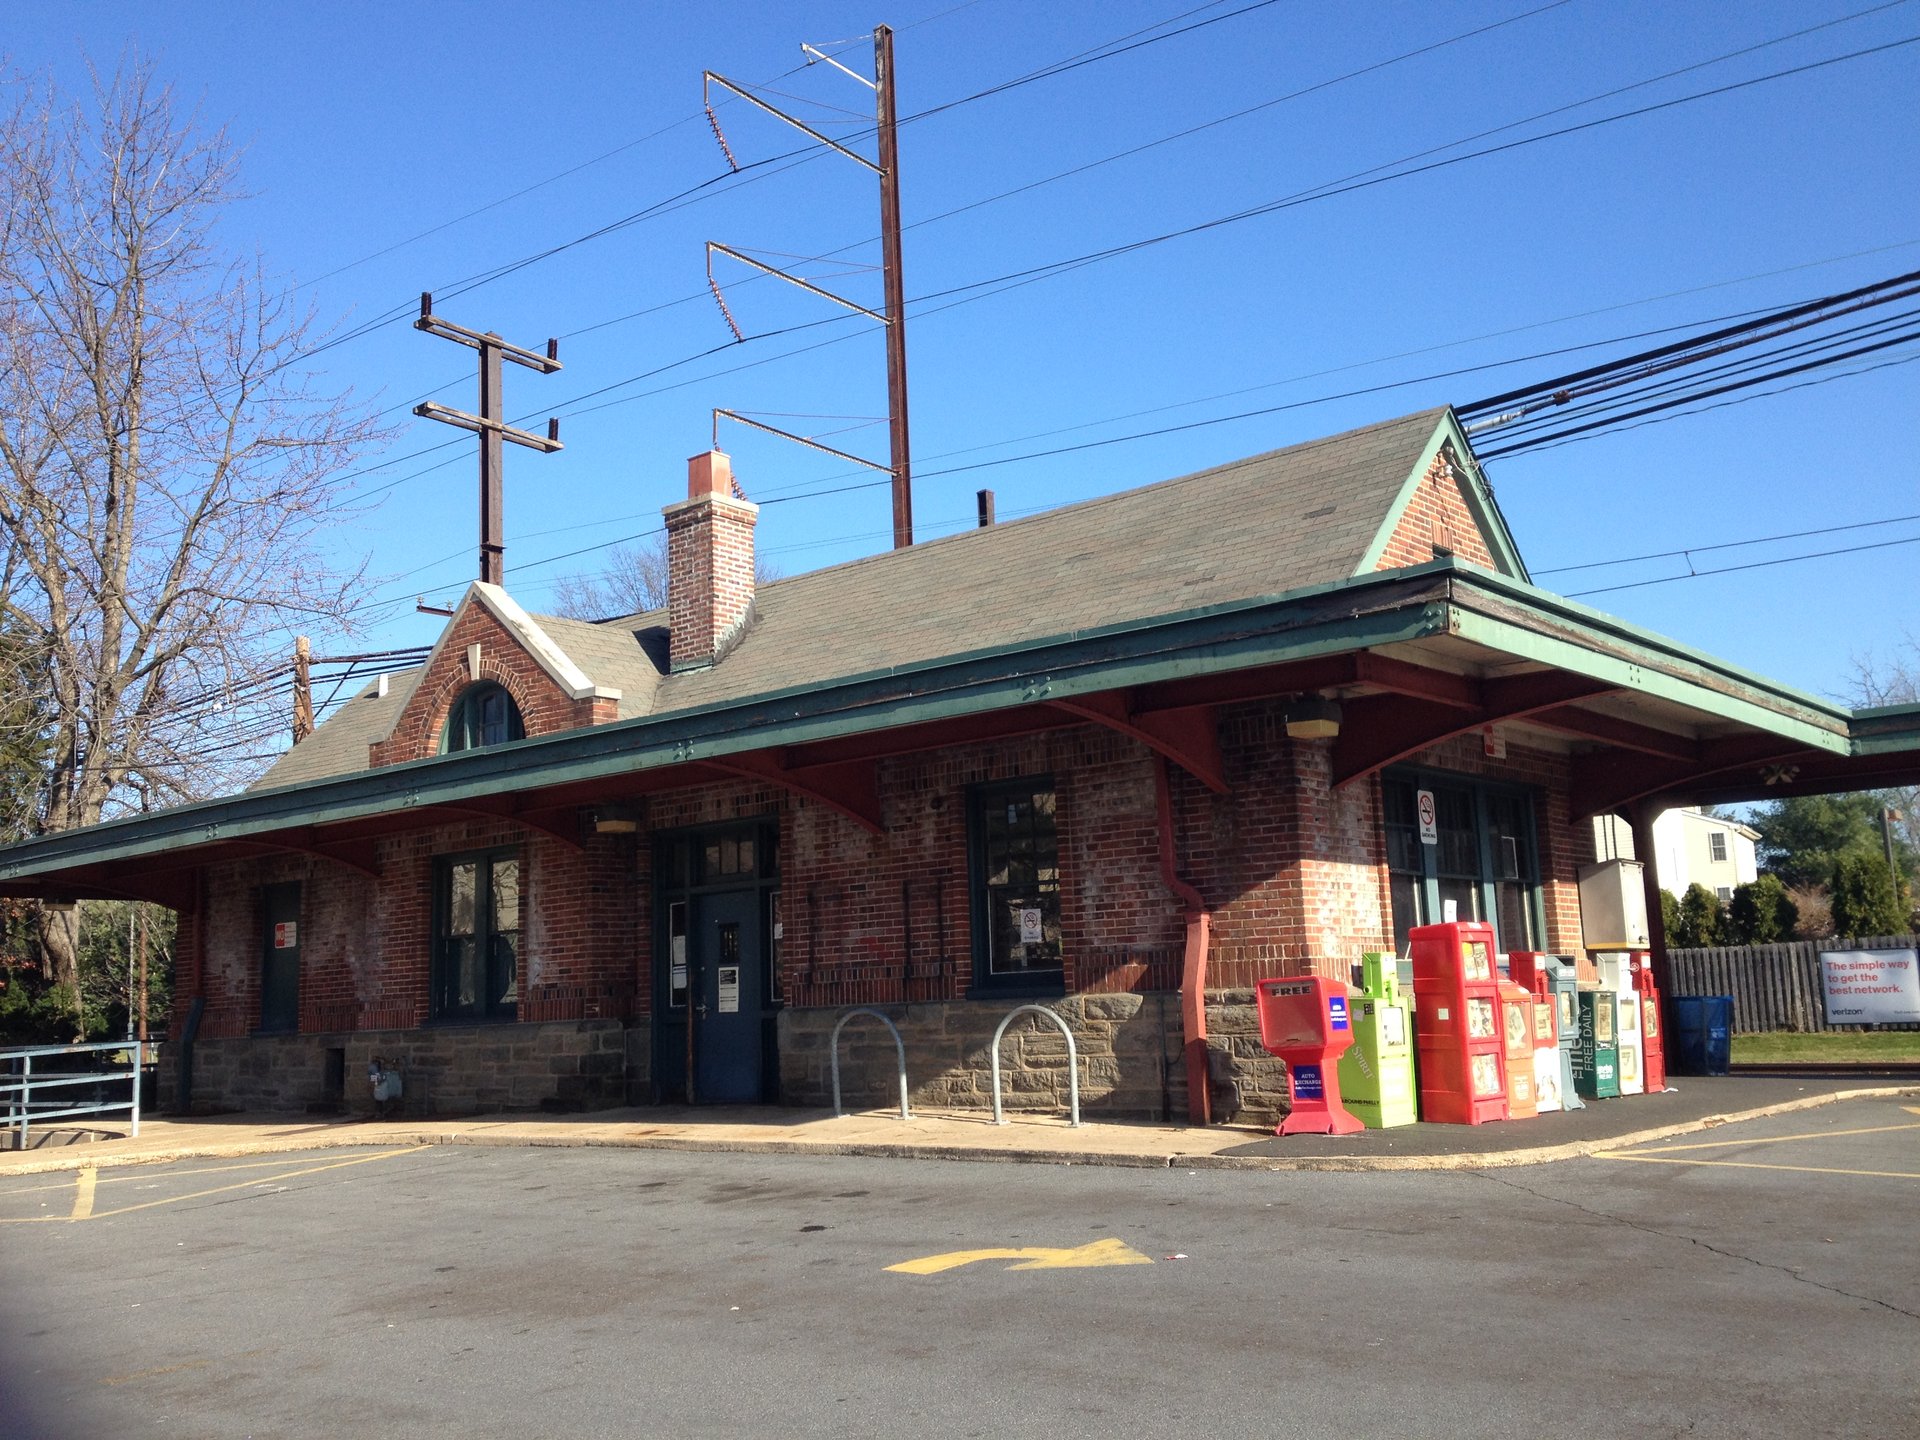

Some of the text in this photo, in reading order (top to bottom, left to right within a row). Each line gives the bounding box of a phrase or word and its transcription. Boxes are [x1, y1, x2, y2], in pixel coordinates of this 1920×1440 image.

[1826, 961, 1910, 971] The simple way
[1841, 974, 1858, 984] get
[1861, 973, 1878, 981] the
[1271, 986, 1311, 996] FREE
[1829, 984, 1904, 995] best network.
[1582, 1004, 1593, 1071] FREE DAILY
